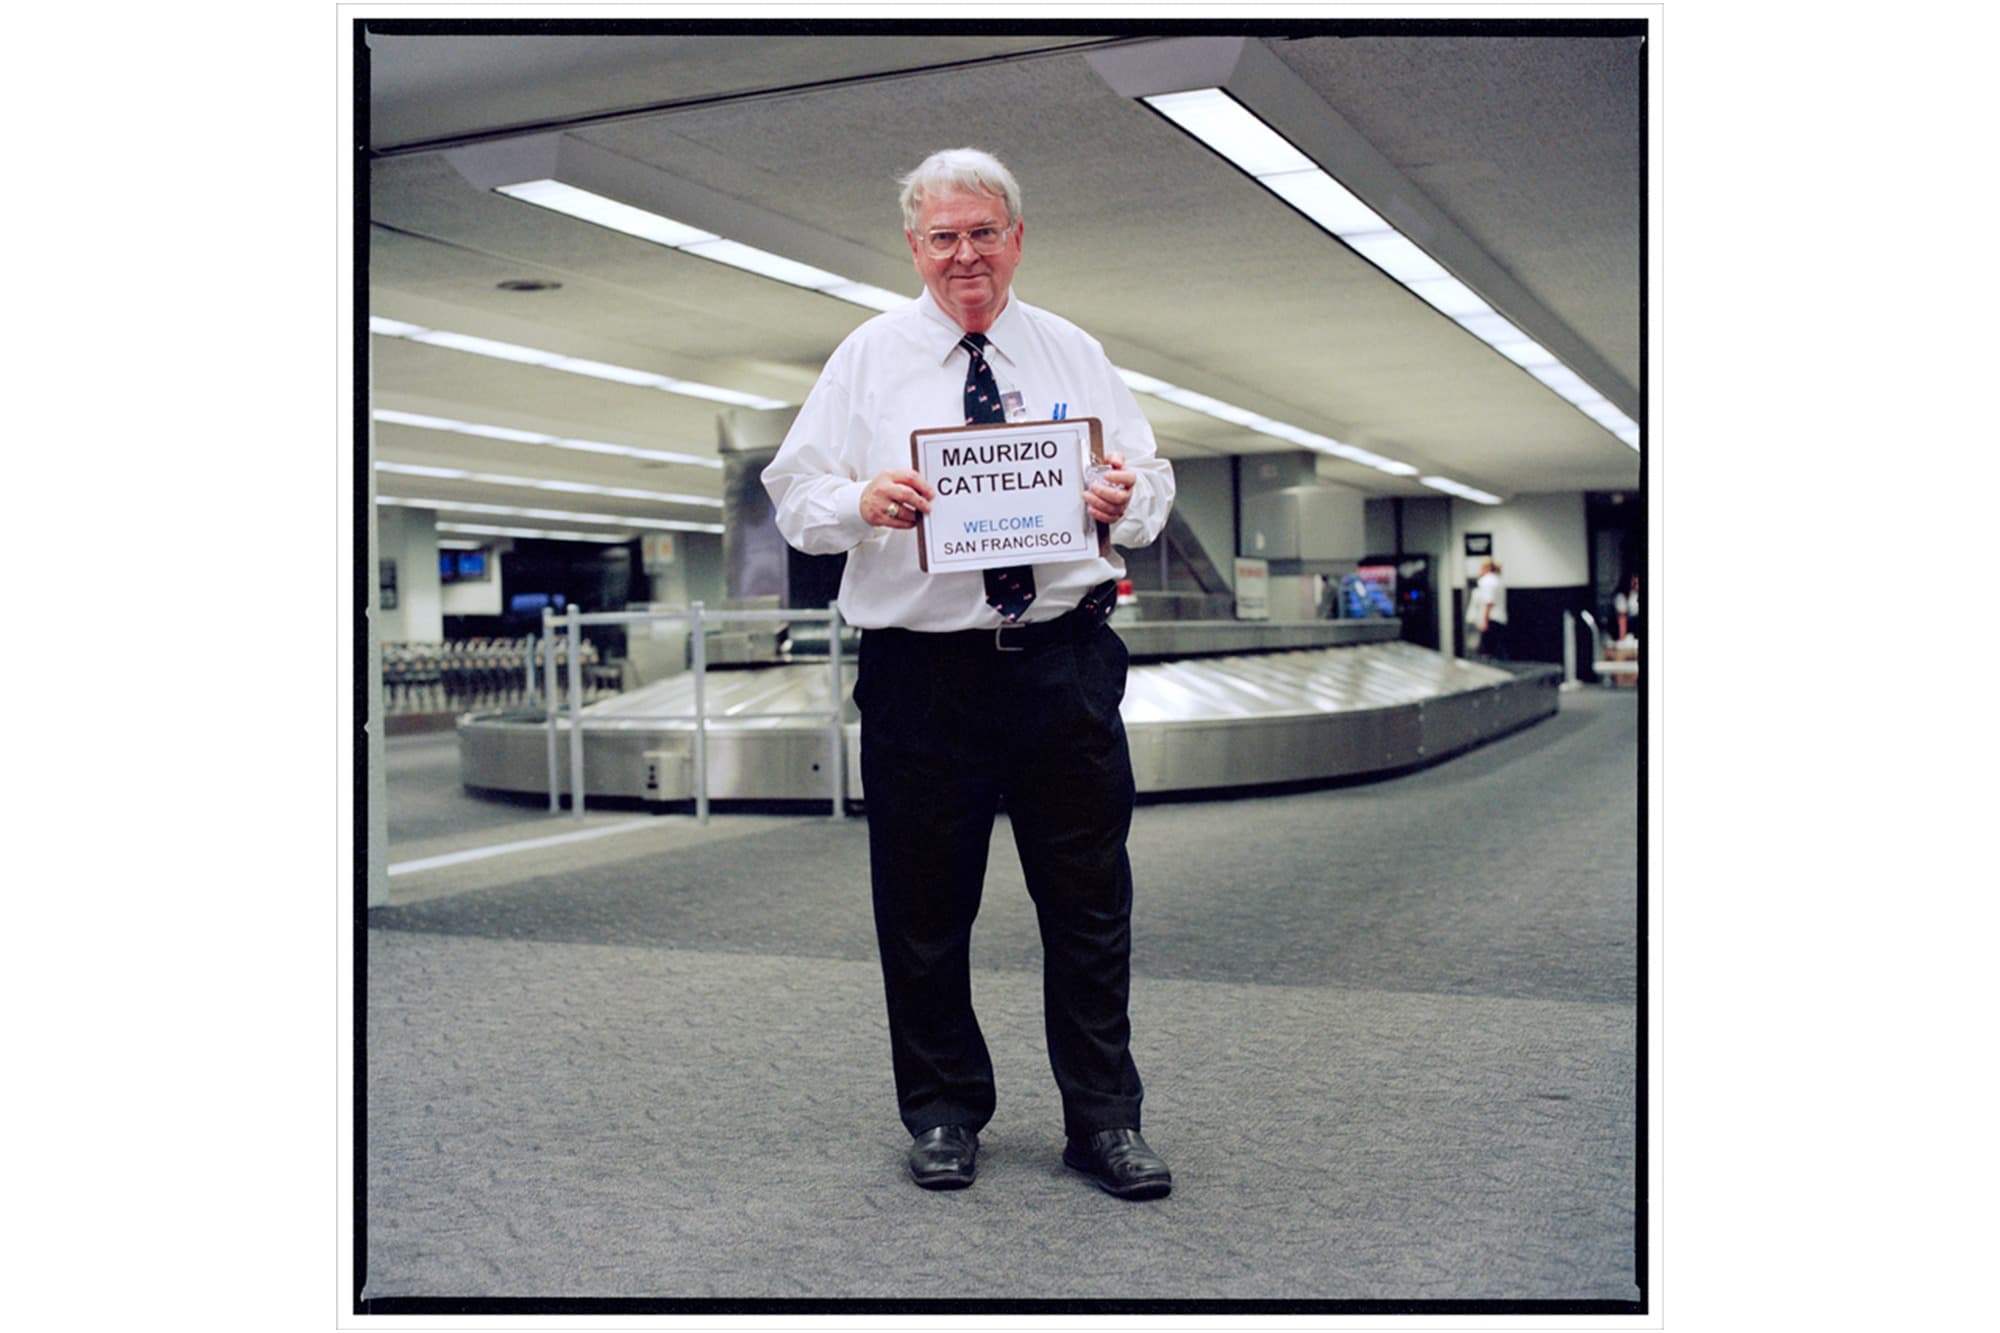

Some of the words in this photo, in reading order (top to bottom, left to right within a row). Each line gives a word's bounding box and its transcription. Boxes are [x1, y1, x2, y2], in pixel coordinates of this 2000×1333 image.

[942, 440, 1058, 467] MAURIZIO
[937, 468, 1063, 496] CATTELAN
[963, 515, 1045, 533] WELCOME
[943, 541, 976, 555] SAN
[981, 531, 1072, 552] FRANCISCO
